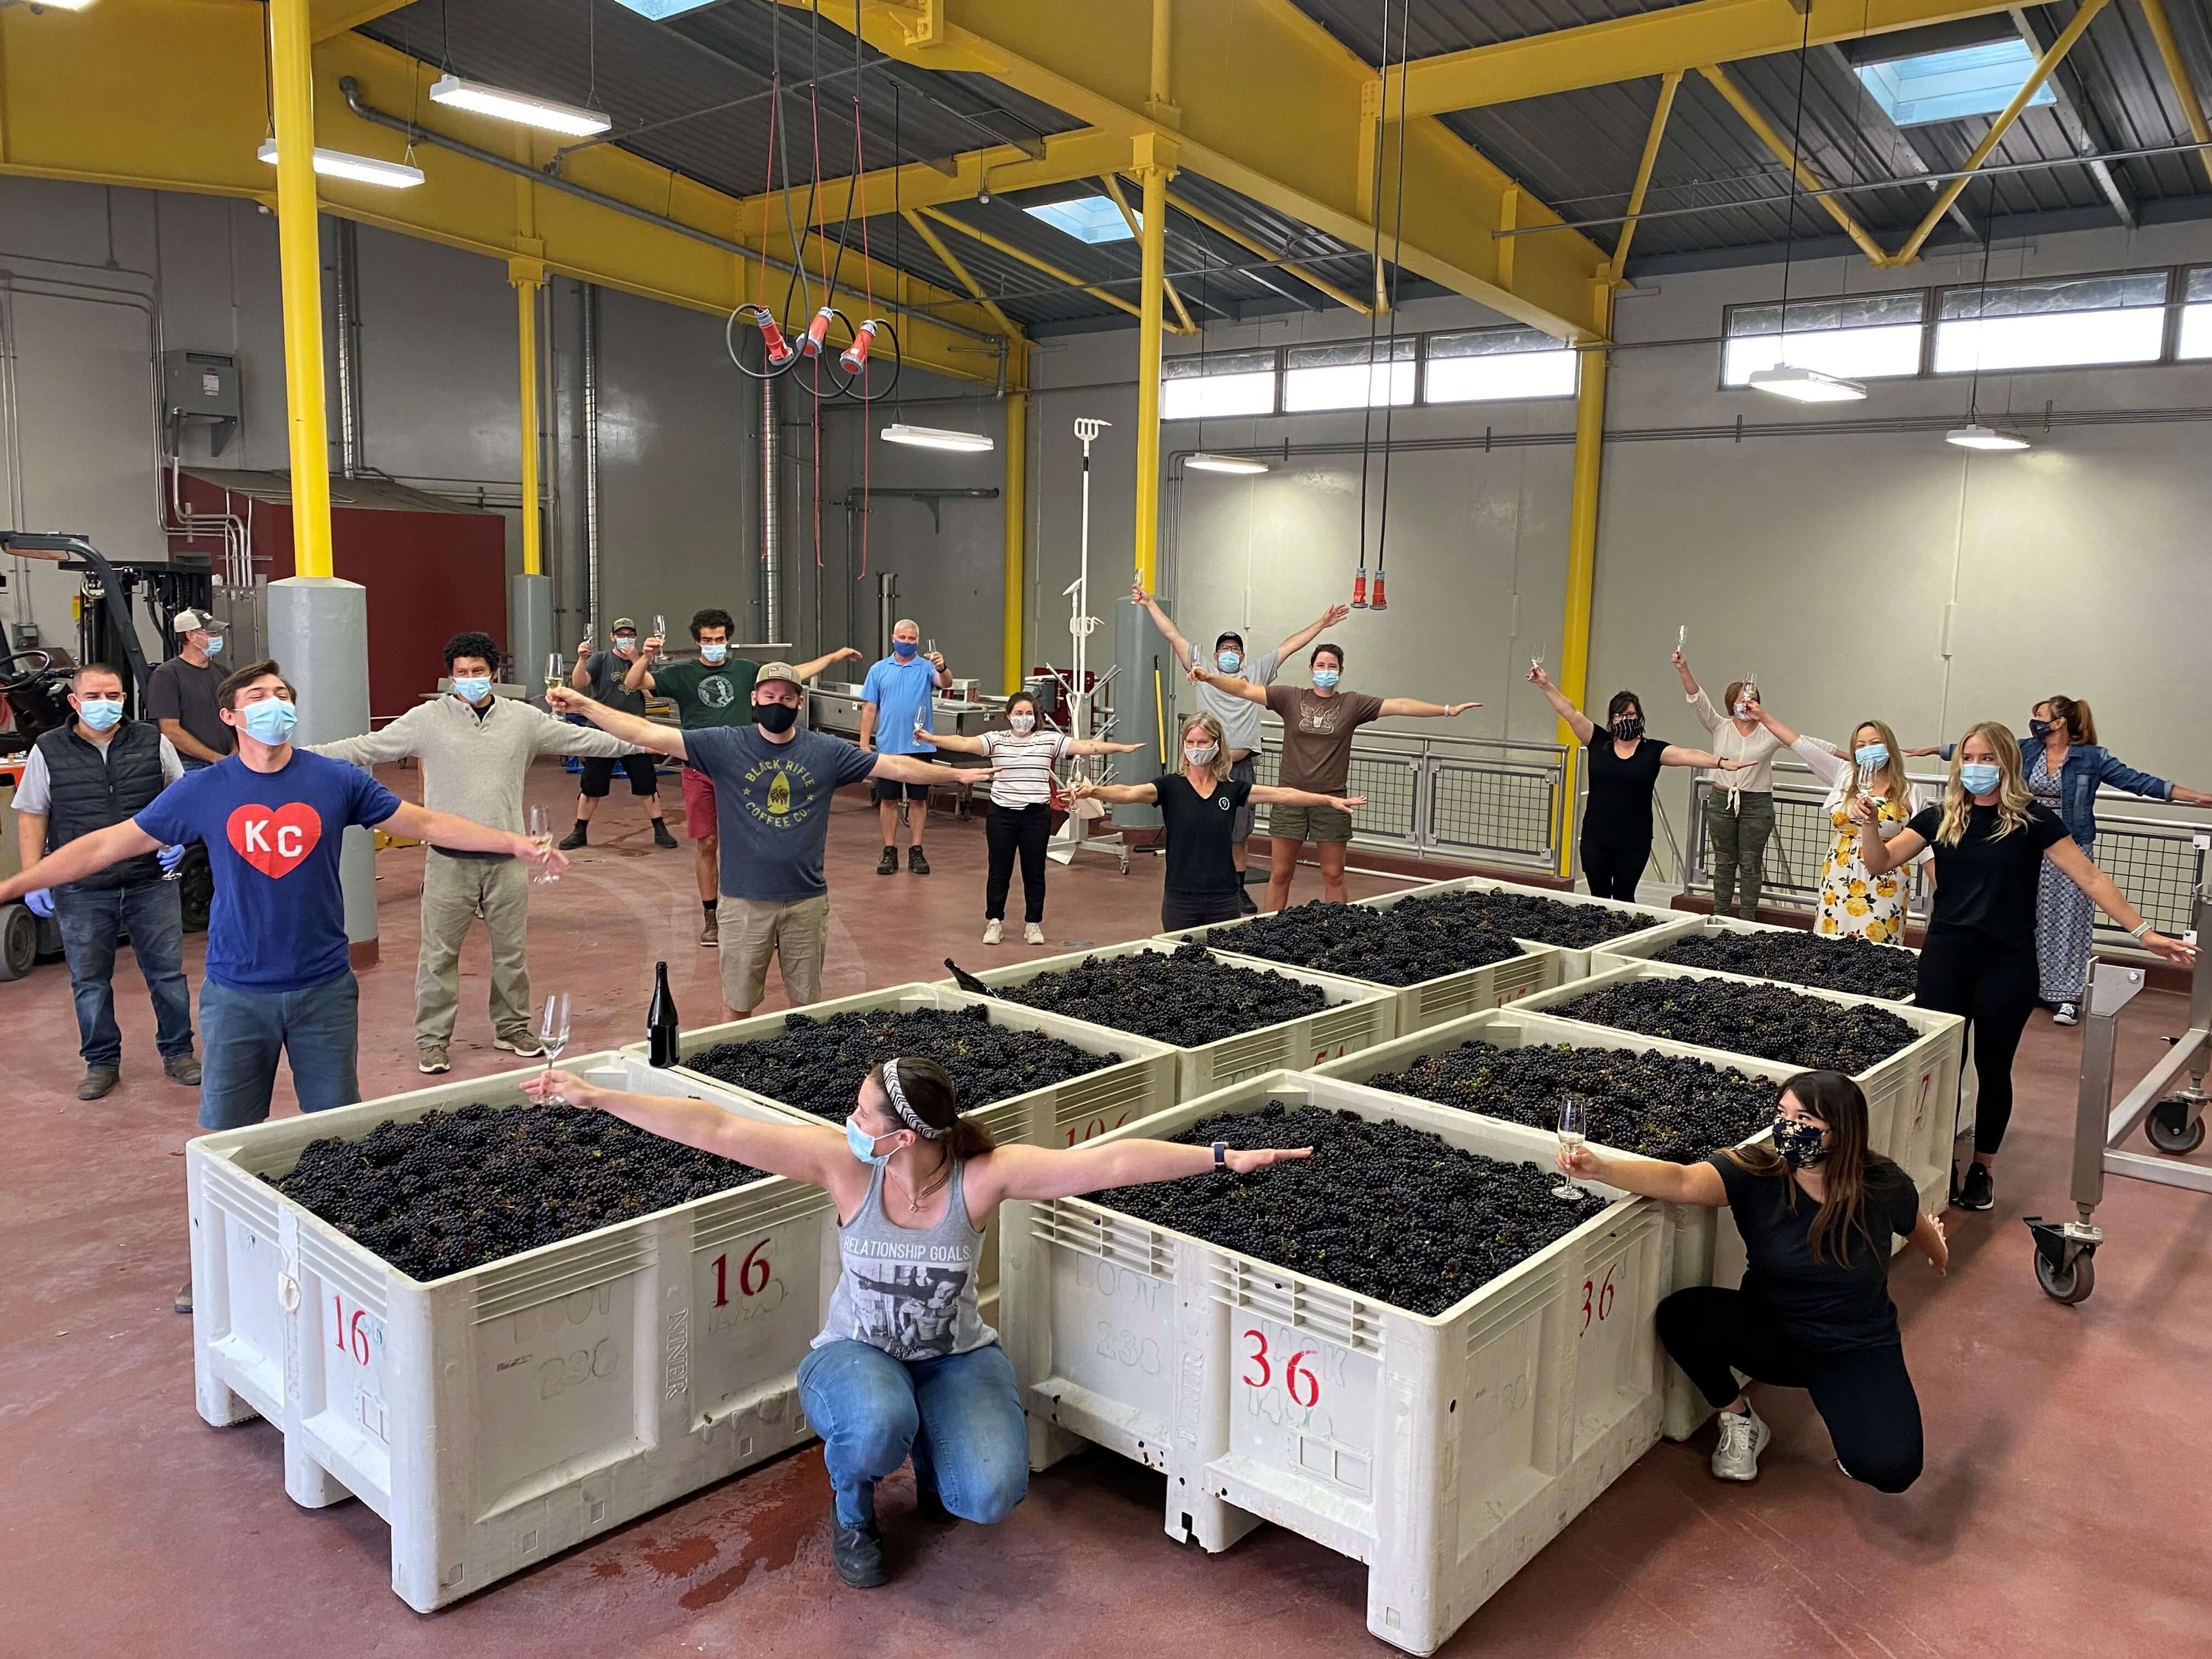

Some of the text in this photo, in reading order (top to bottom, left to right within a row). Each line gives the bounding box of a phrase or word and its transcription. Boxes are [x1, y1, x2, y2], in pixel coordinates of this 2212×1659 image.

[744, 759, 815, 787] BLACK RIFLE
[245, 818, 303, 858] KC
[745, 801, 810, 827] COFFEE CO.
[711, 1237, 771, 1309] 16
[843, 1235, 973, 1262] RELATIONSHIP GOALS:
[333, 1294, 370, 1366] 16
[1579, 1262, 1618, 1338] 36
[665, 1307, 689, 1402] NINER
[1242, 1329, 1320, 1408] 36
